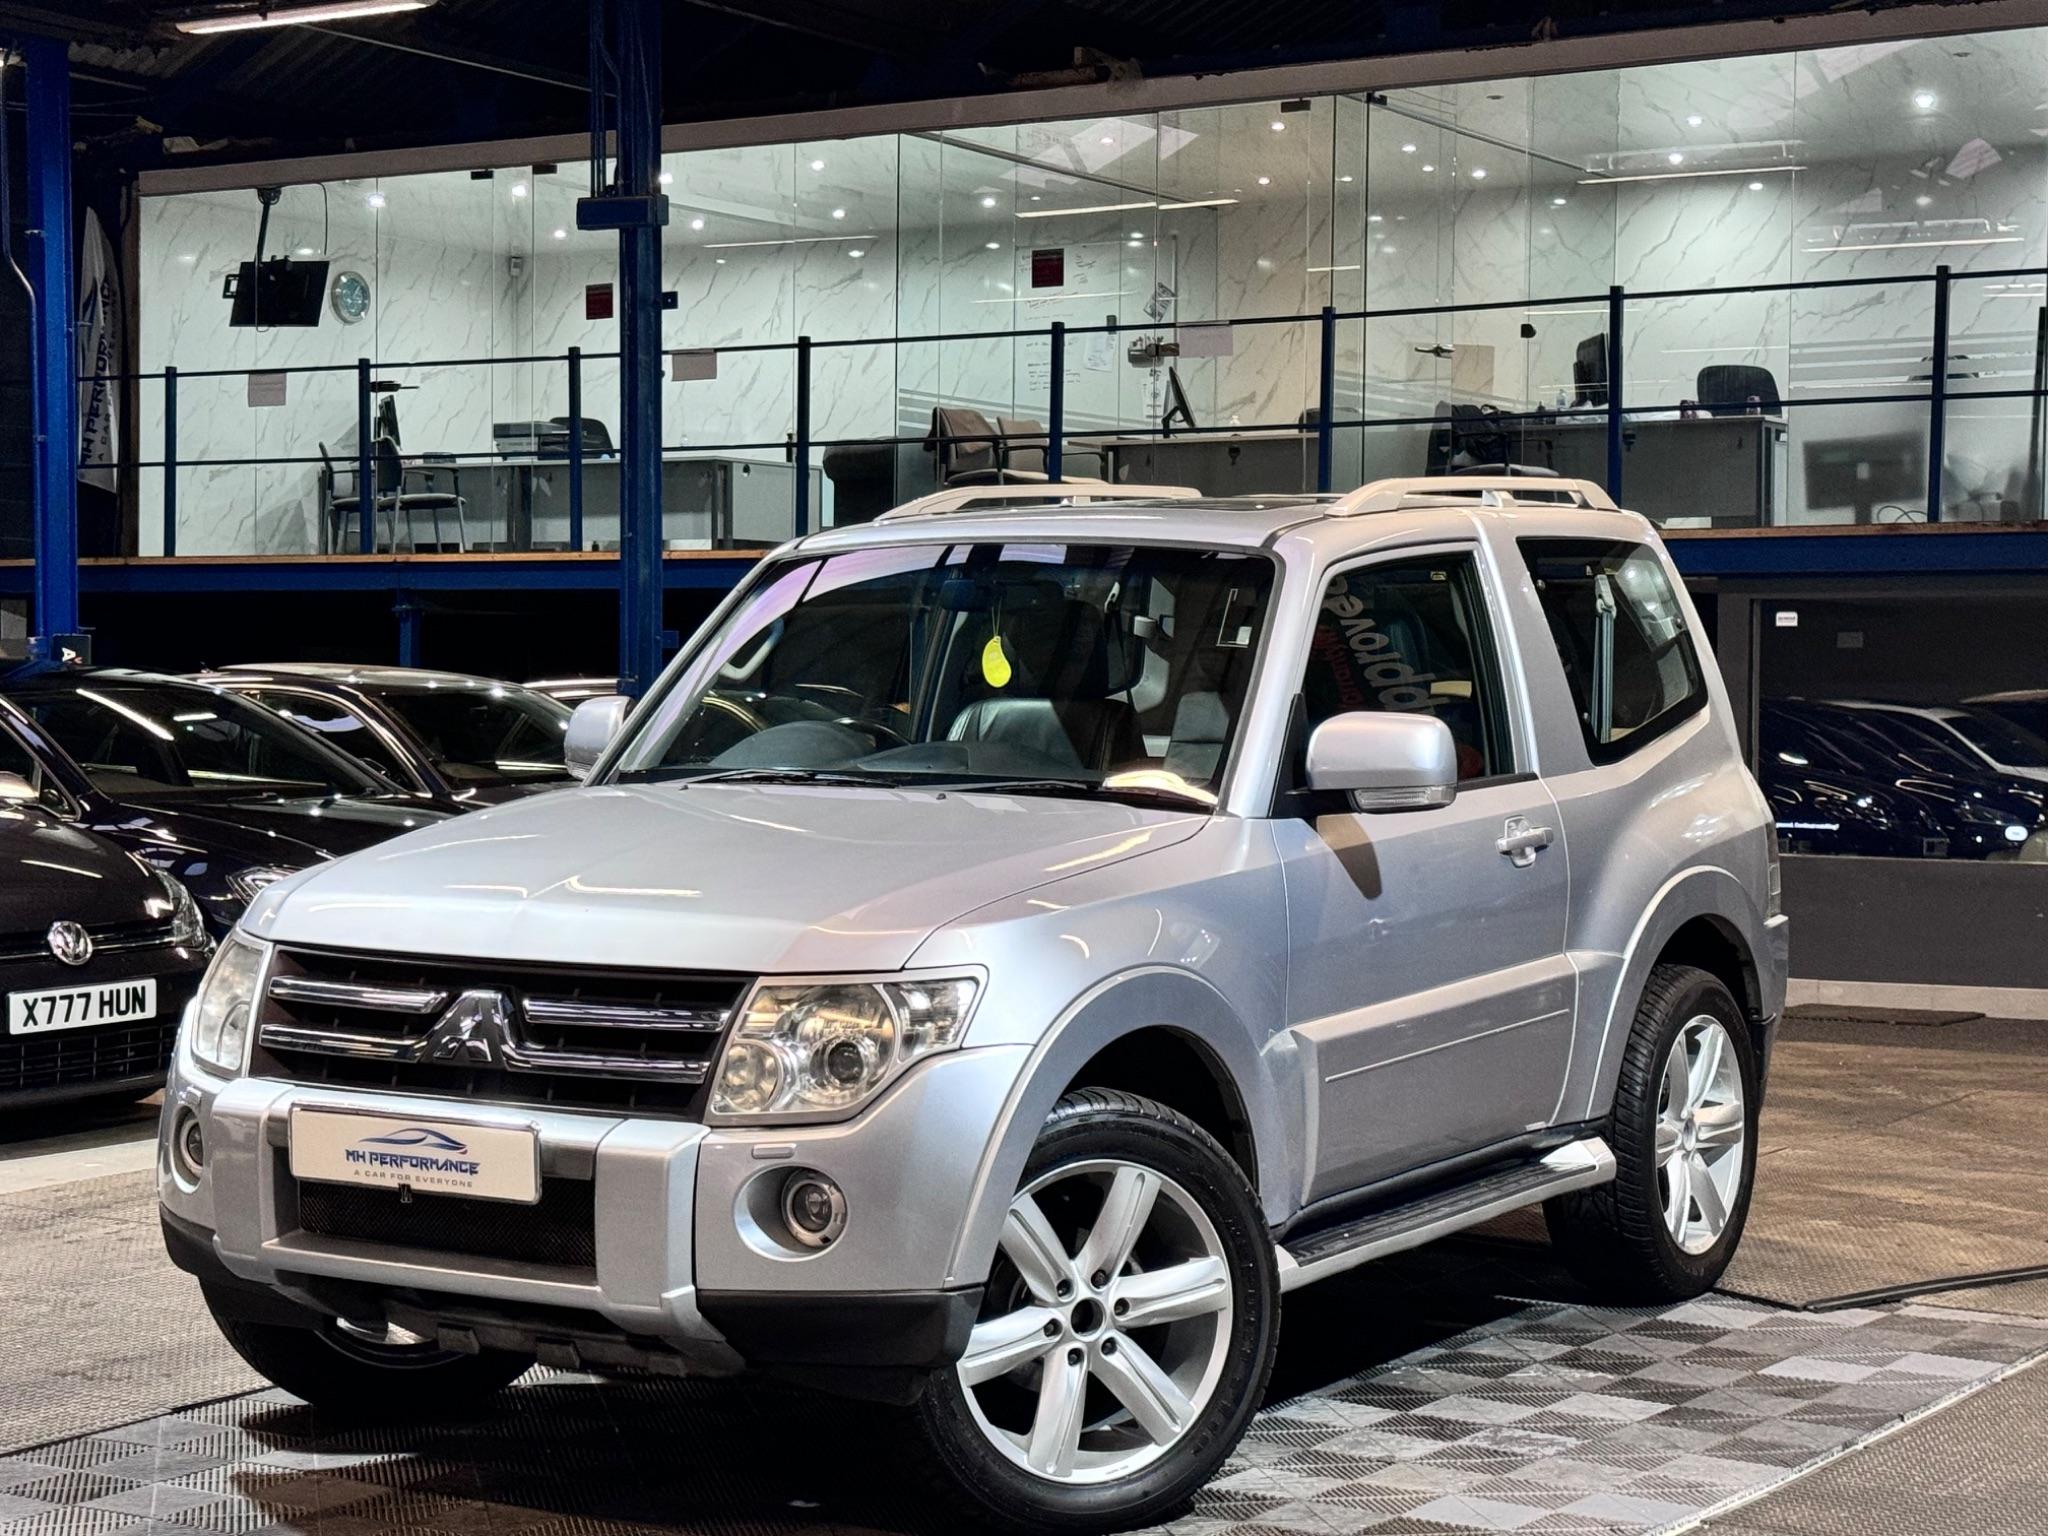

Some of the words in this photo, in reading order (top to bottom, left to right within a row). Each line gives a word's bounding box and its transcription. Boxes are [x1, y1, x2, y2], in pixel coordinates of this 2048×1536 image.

[22, 992, 92, 1028] X777
[99, 985, 147, 1019] HUN
[345, 1149, 366, 1163] MH
[369, 1151, 481, 1176] PERFORMANCE
[354, 1169, 362, 1177] A
[364, 1170, 387, 1179] CAR
[390, 1172, 412, 1182] FOR
[415, 1176, 473, 1188] EVERYONE
